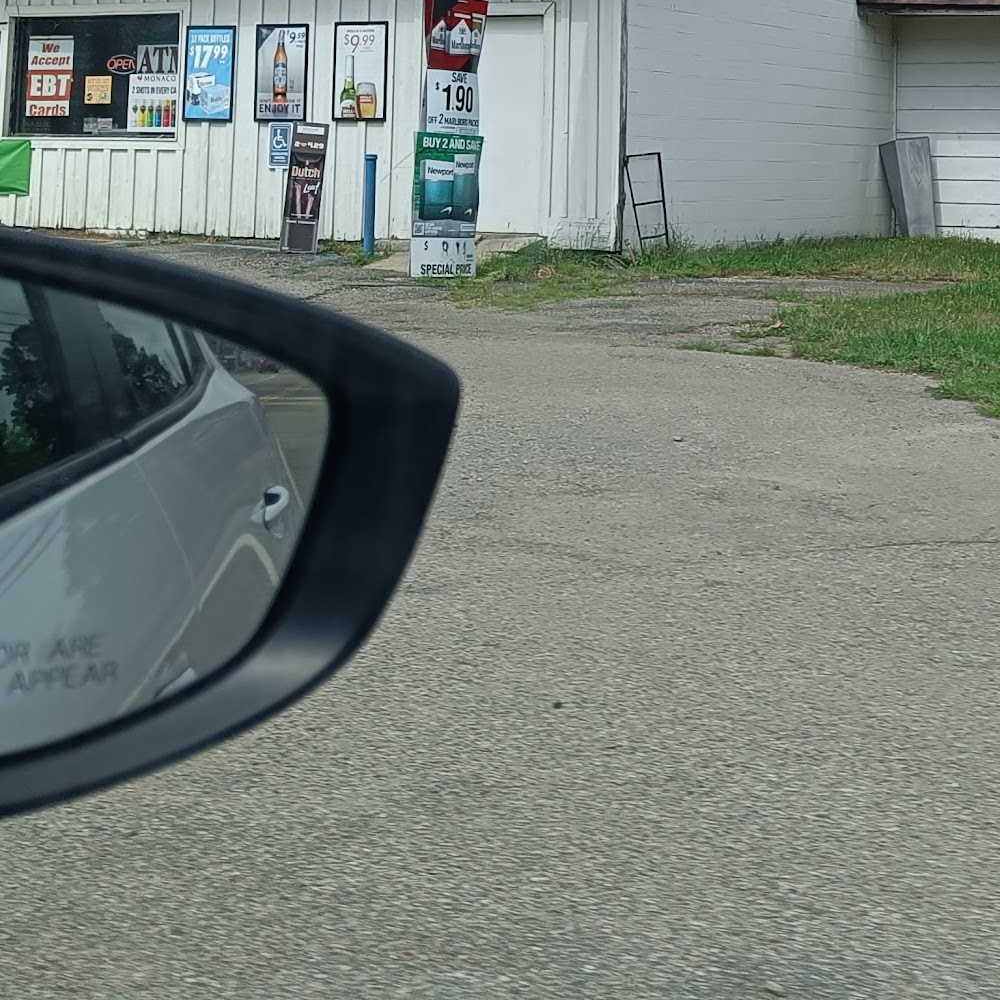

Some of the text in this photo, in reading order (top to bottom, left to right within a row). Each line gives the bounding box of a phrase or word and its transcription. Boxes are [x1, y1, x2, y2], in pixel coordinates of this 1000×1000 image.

[41, 42, 60, 54] We
[31, 55, 71, 66] Accept
[107, 58, 136, 70] OPEN
[451, 72, 468, 84] SAVE
[29, 74, 71, 97] EBT
[29, 104, 66, 117] Cards
[259, 104, 301, 113] ENJOY IT
[422, 136, 441, 148] BUY
[442, 138, 448, 149] 2
[449, 138, 465, 150] AND
[291, 165, 321, 178] Dutch
[427, 166, 454, 176] Newport
[420, 263, 453, 274] SPECIAL
